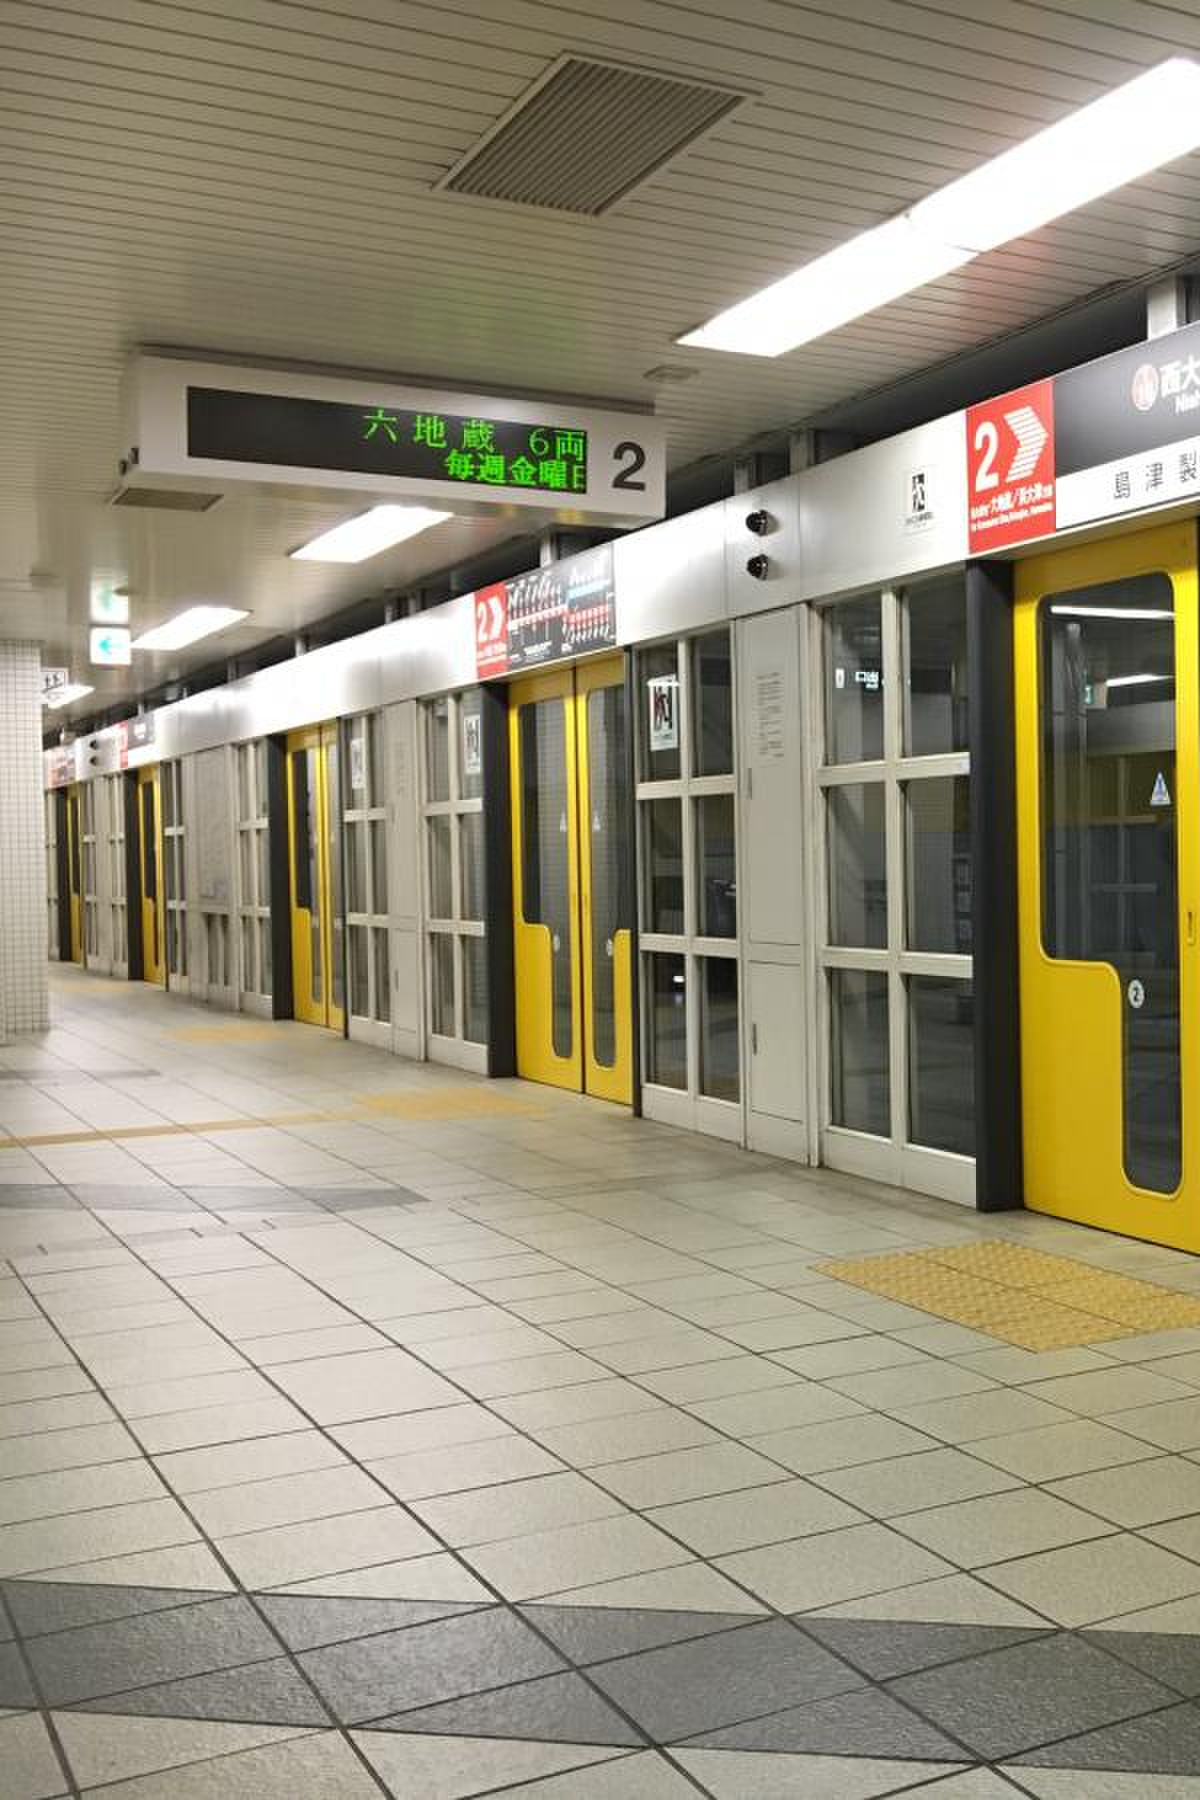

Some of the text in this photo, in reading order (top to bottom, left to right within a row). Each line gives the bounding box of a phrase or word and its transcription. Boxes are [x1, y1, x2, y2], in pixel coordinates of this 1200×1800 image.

[363, 409, 585, 462] 六地蔵 6両
[975, 421, 999, 493] 2
[612, 441, 647, 491] 2
[478, 601, 489, 644] 2
